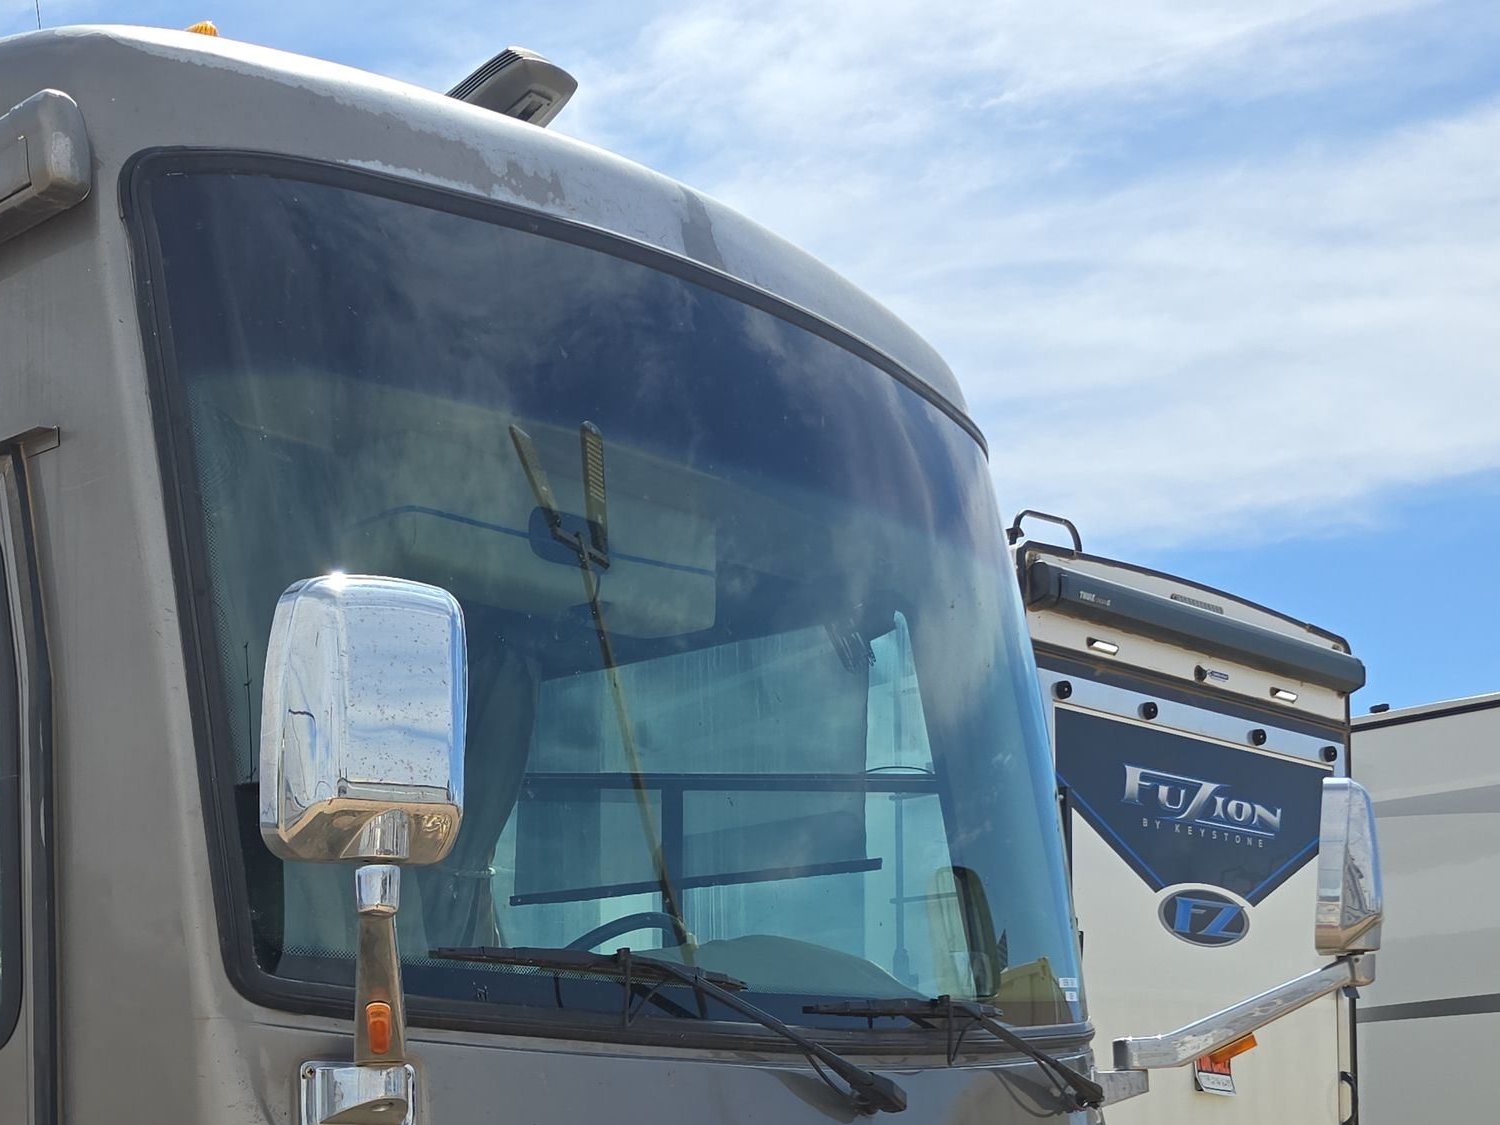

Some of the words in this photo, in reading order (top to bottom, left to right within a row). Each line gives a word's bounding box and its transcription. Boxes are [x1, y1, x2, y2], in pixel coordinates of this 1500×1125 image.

[1142, 817, 1161, 830] BY
[1174, 823, 1264, 848] KEYSTONE
[1171, 896, 1245, 938] FZ
